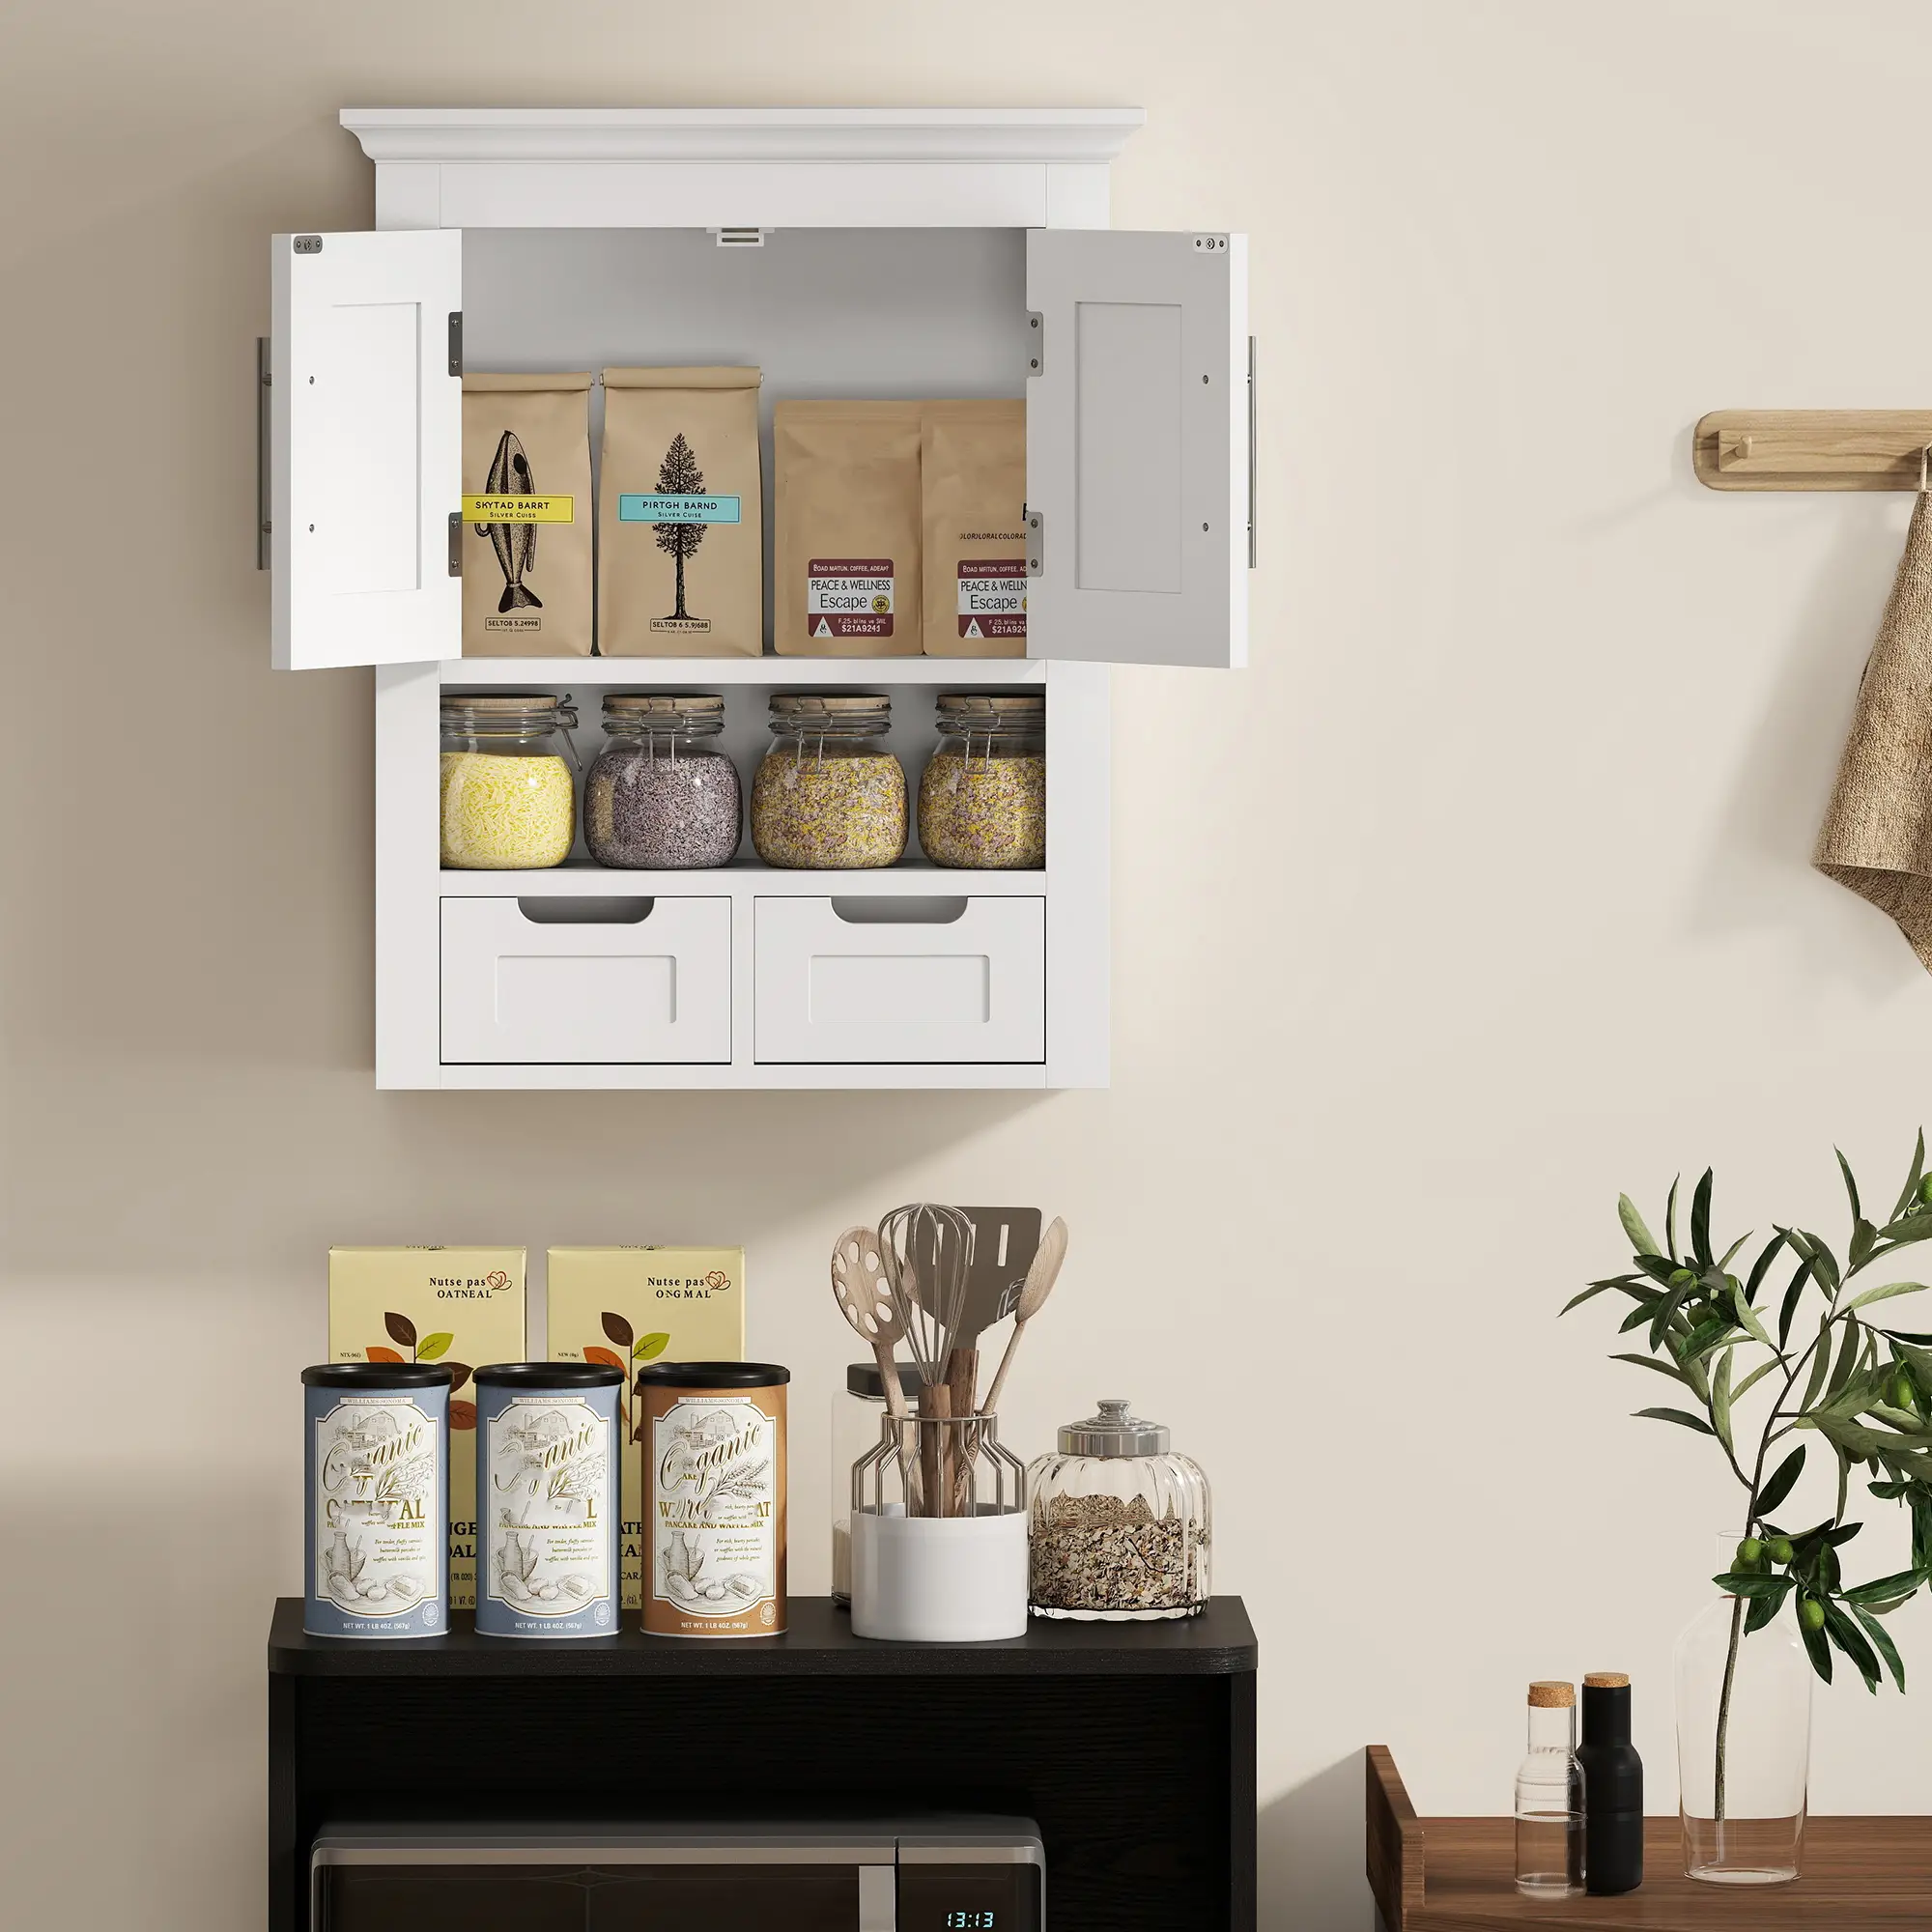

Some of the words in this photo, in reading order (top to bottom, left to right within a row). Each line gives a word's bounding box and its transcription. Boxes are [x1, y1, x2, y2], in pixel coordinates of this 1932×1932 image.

[475, 501, 514, 510] SKYTAD
[811, 580, 839, 590] PEACE
[841, 580, 848, 590] &
[850, 580, 891, 591] WELLNESS
[961, 581, 990, 591] PEACE
[991, 581, 998, 591] &
[1000, 581, 1027, 591] WELLN
[820, 593, 867, 611] Escape
[971, 595, 1017, 611] Escape
[429, 1277, 462, 1286] Nutse
[467, 1279, 486, 1288] pas
[647, 1277, 680, 1286] Nutse
[686, 1279, 704, 1288] pas
[438, 1290, 493, 1298] OATNEAL
[947, 1912, 994, 1928] 13:13
